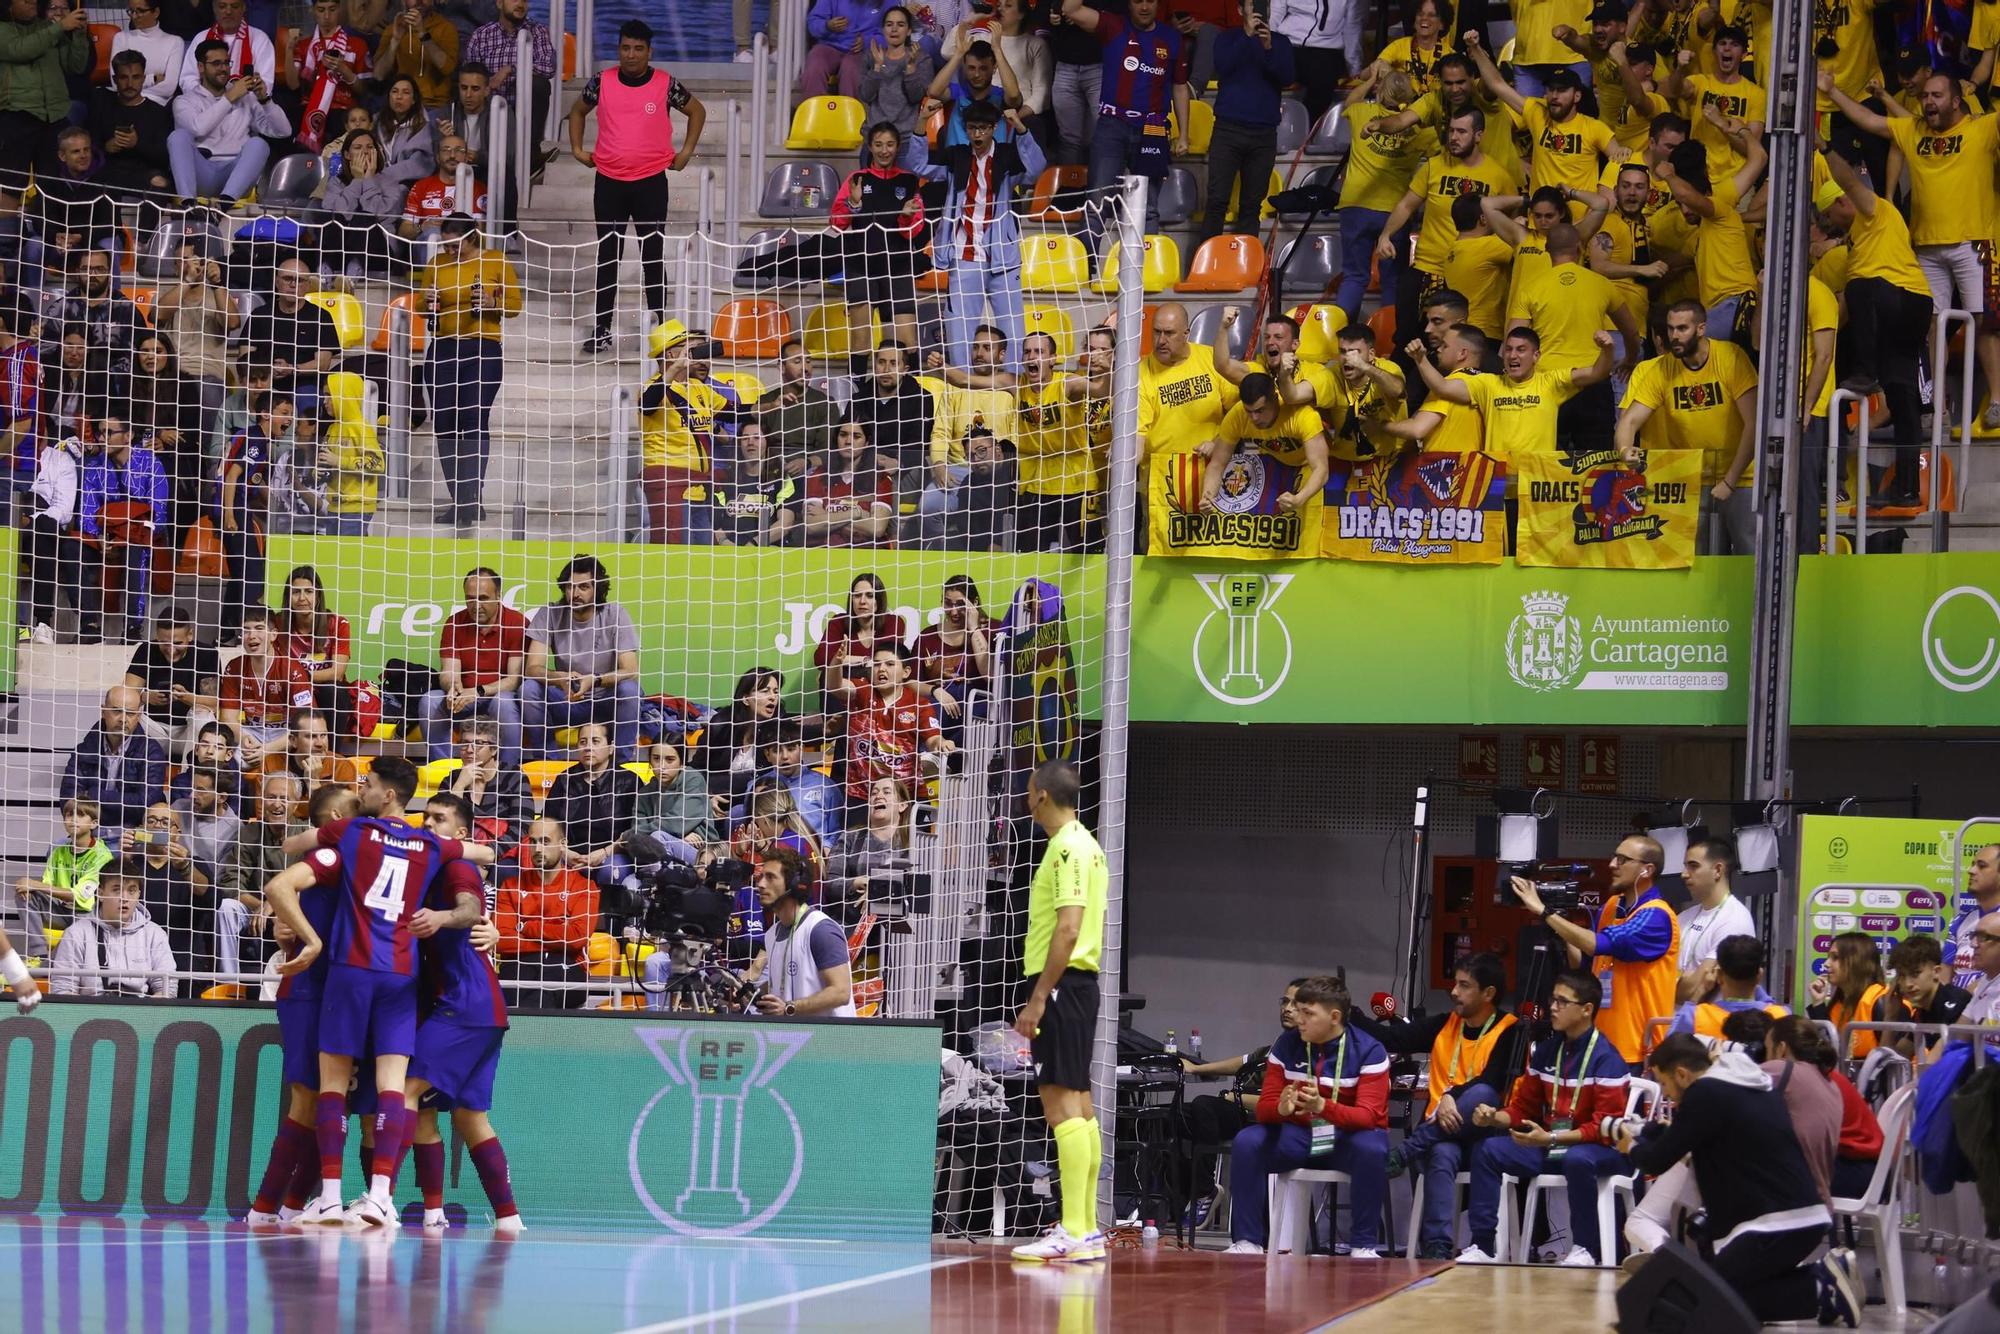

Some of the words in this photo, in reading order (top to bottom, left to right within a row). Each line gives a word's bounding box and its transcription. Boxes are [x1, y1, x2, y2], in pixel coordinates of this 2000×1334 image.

[1140, 62, 1166, 76] Spotif
[1141, 147, 1161, 155] BARÇA
[1158, 374, 1211, 395] SUPPORTERS
[1160, 387, 1192, 405] CORBA
[1193, 382, 1213, 395] SUD
[1531, 481, 1579, 503] DRACS
[1653, 482, 1687, 504] 1991
[1169, 514, 1301, 550] DRACS1991
[1338, 506, 1424, 540] DRACS
[1427, 507, 1484, 543] 1991
[1612, 518, 1655, 537] BLAUGRANA
[1371, 538, 1400, 554] Palau
[1400, 540, 1453, 558] Blaugrana
[1591, 615, 1730, 637] Ayuntamiento
[1590, 637, 1729, 670] Cartagena
[1614, 673, 1725, 689] www.cartagena.es
[1581, 783, 1616, 791] EXTINTOR
[370, 828, 383, 843] A.
[1904, 842, 1926, 856] COPA
[1927, 842, 1937, 856] DE
[364, 854, 410, 922] 4
